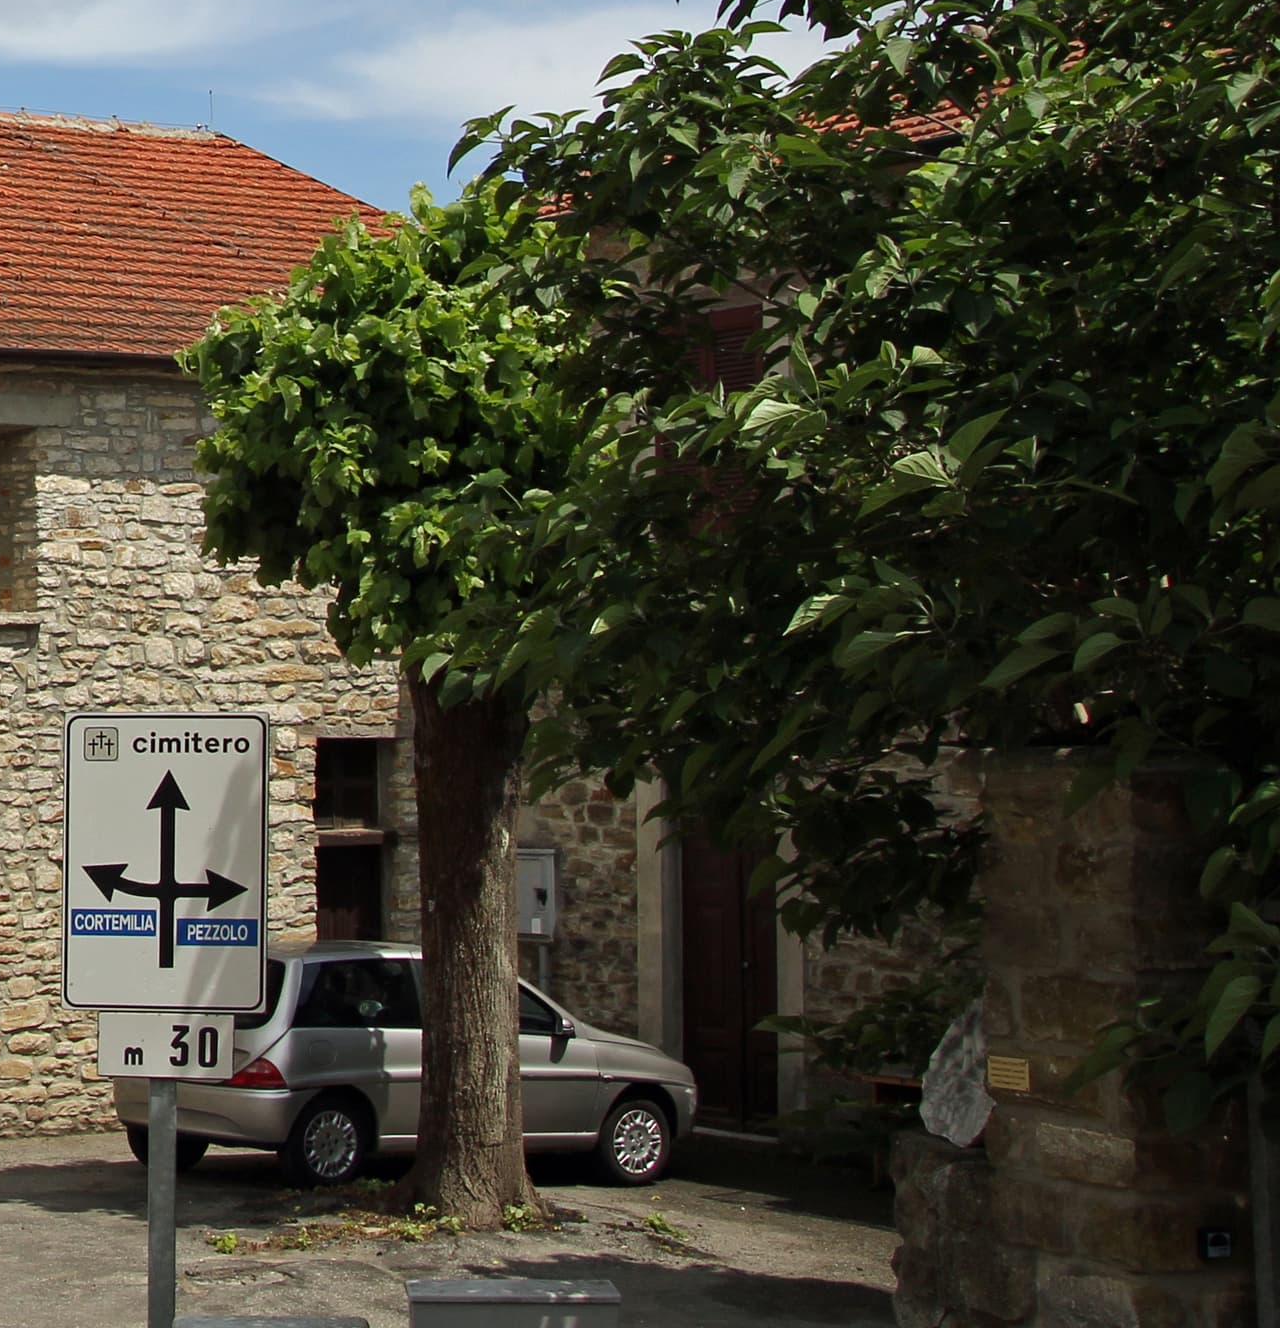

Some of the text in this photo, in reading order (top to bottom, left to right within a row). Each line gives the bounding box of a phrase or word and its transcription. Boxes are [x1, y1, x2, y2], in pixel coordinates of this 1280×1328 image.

[132, 732, 251, 754] cimitero
[74, 913, 154, 933] CORTEMILIA
[186, 924, 249, 942] PEZZOLO
[123, 1024, 219, 1068] m 30
